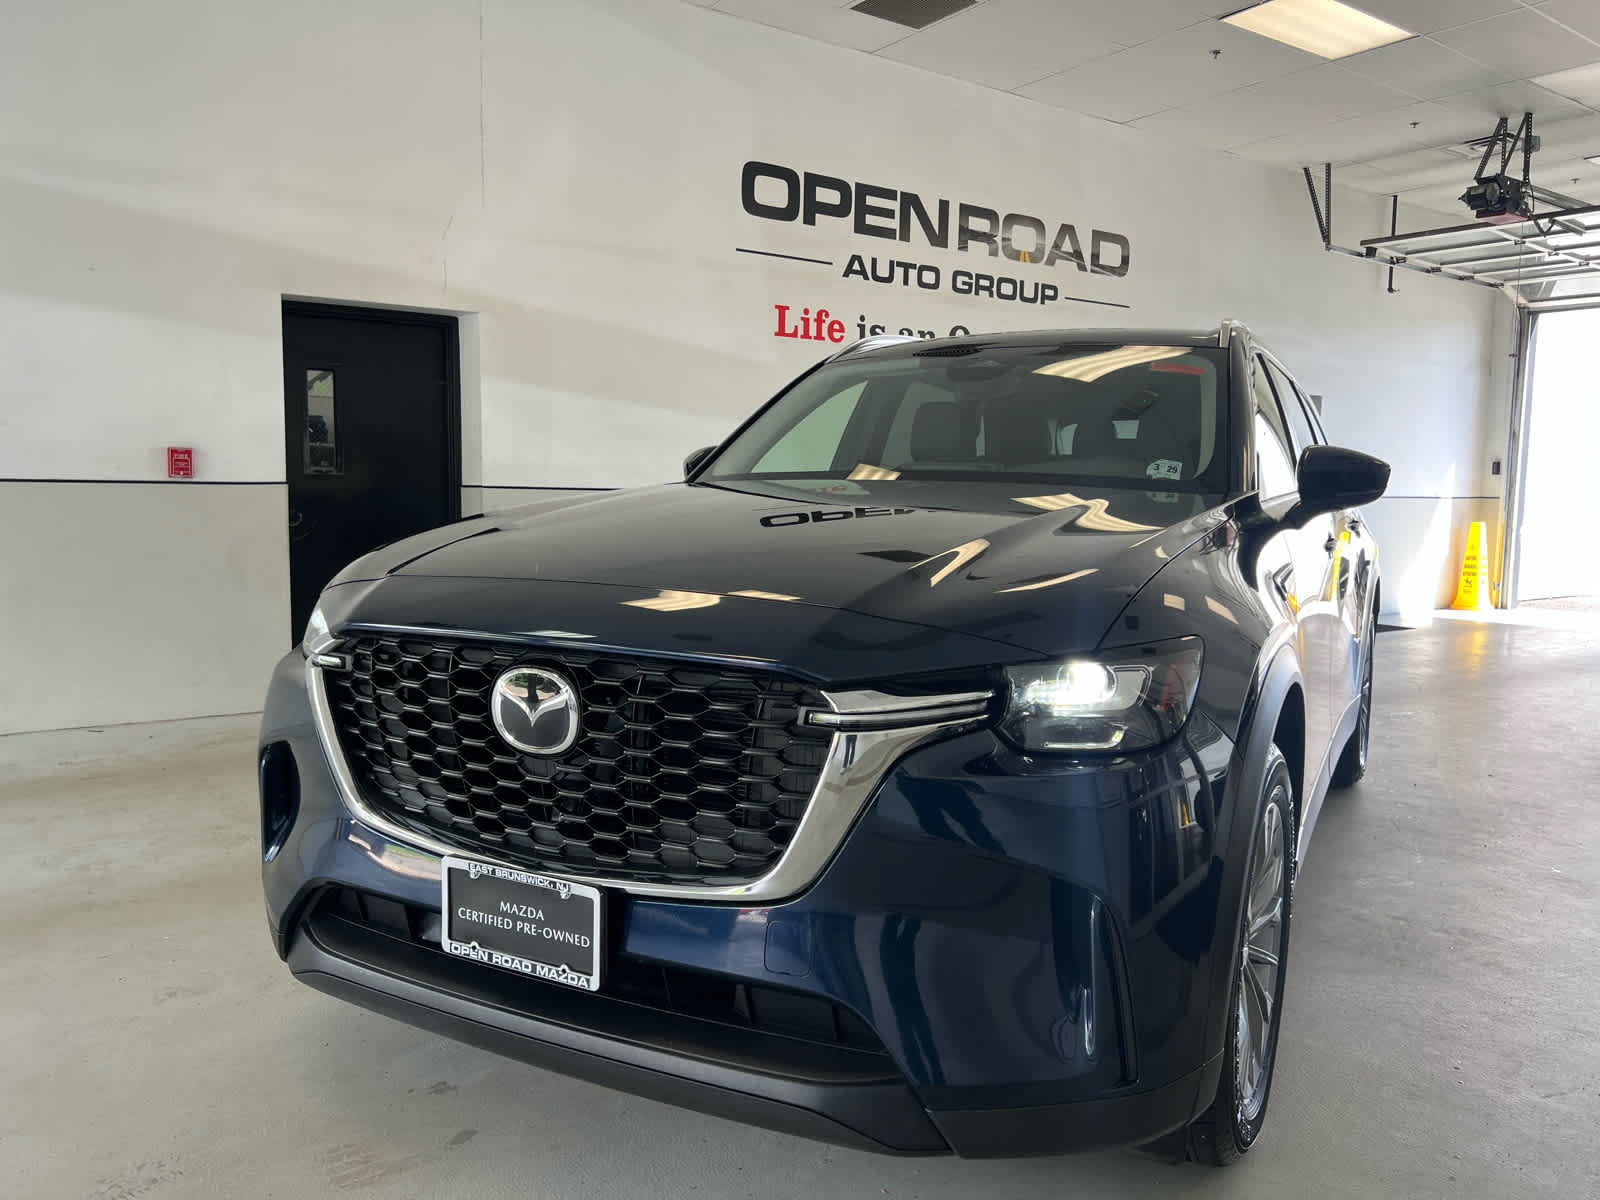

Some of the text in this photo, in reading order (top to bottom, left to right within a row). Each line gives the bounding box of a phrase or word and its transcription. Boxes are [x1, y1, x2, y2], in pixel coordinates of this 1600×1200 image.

[842, 254, 1059, 305] AUTO GROUP
[774, 304, 846, 343] Life
[469, 863, 494, 876] EAST
[555, 881, 570, 892] NJ
[457, 907, 590, 948] CERTIFIED PRE-OWNED
[499, 900, 545, 921] MAZDA
[451, 943, 589, 988] OPEN ROAD MAZDA
